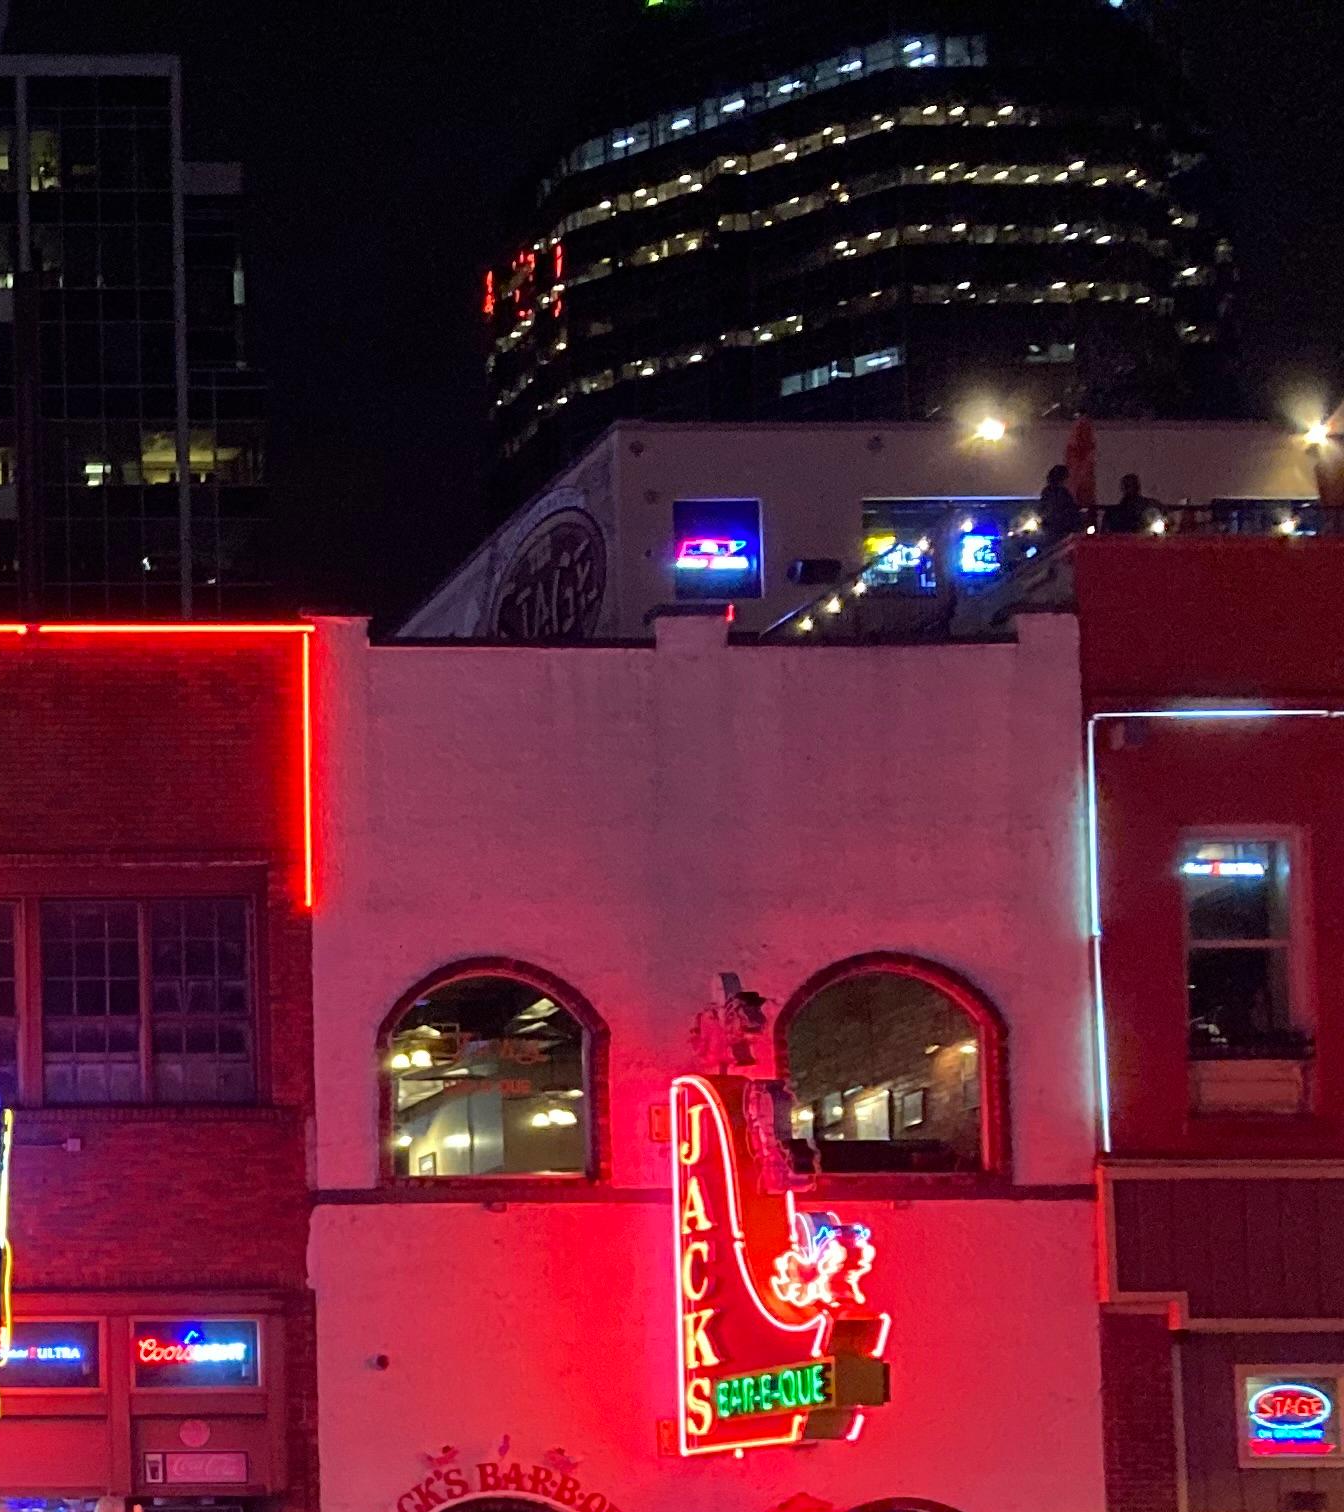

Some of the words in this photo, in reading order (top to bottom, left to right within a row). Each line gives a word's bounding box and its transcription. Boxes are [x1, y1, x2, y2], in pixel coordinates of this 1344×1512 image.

[680, 1103, 720, 1437] JACKS
[36, 1346, 81, 1359] ULTRA
[138, 1338, 194, 1362] Coors
[1254, 1392, 1325, 1419] STAGE
